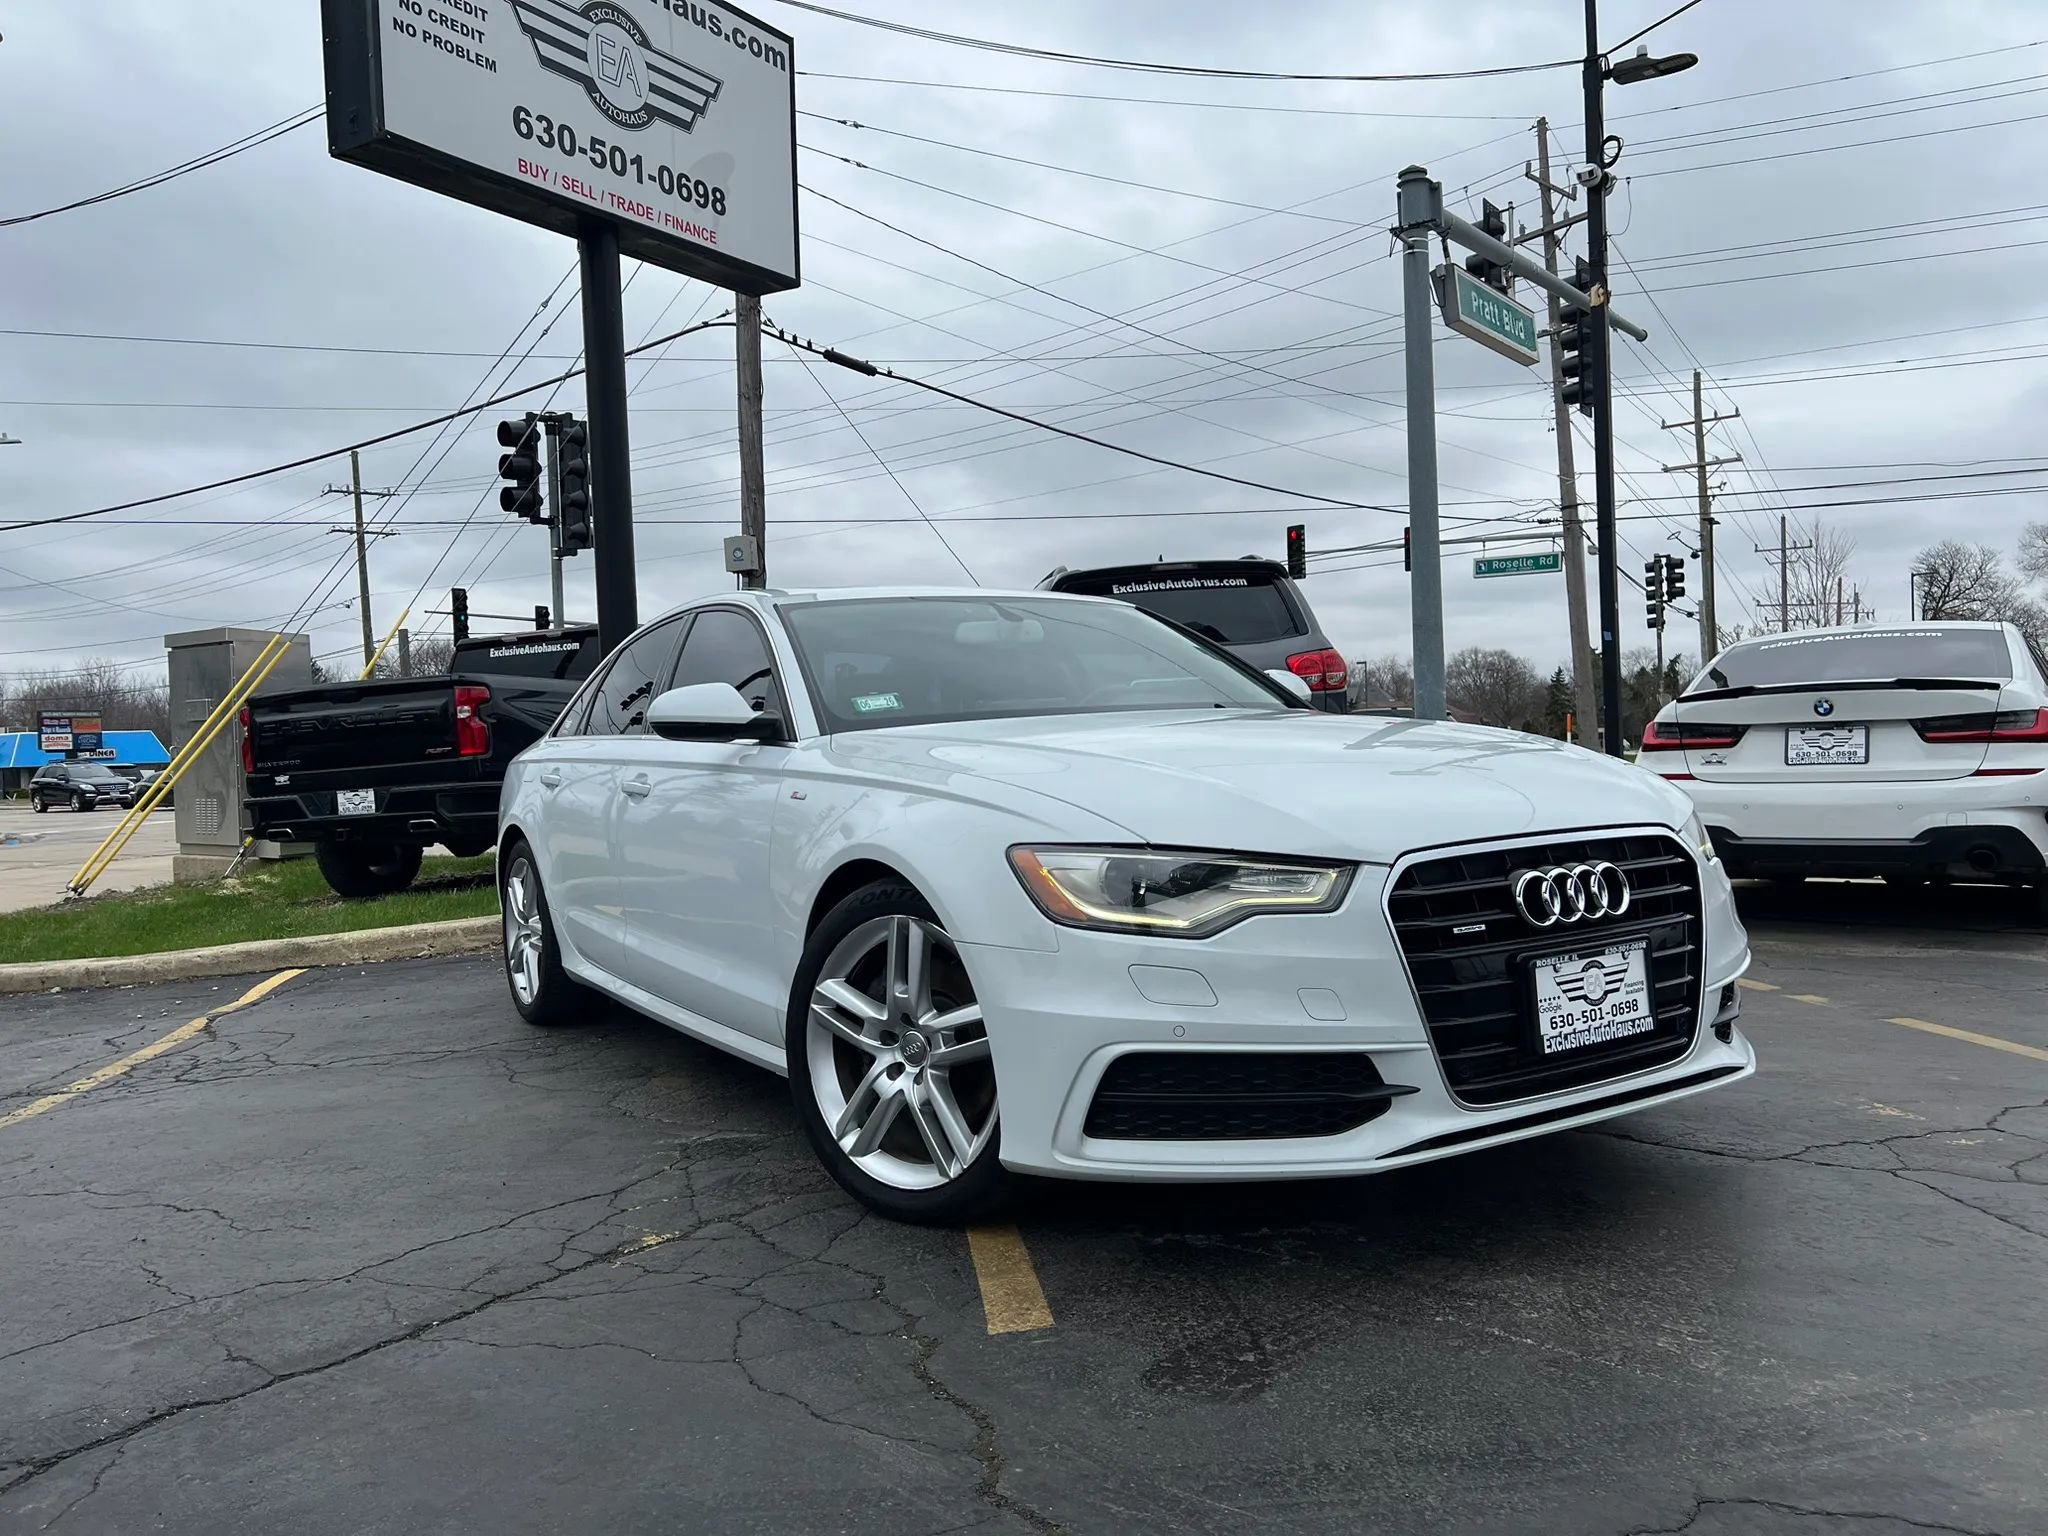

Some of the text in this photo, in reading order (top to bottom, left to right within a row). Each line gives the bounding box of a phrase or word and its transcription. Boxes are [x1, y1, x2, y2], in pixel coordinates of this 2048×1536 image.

[399, 0, 486, 44] NO CREDIT
[589, 8, 643, 44] EXCLUSIVE
[392, 16, 497, 73] NO PROBLEM
[596, 33, 642, 98] EA
[592, 92, 648, 124] AUTOHAUS
[512, 105, 727, 216] 630-501-0698
[518, 158, 717, 244] BUY / SELL / TRADE / FINANCE
[1471, 290, 1525, 340] Pratt Blvd
[1492, 557, 1534, 569] Roselle
[1539, 556, 1553, 565] Rd
[1112, 576, 1248, 594] ExclusiveAutohaus.com
[489, 642, 580, 657] ExclusiveAutohaus.com
[1536, 955, 1569, 967] ROSELLE
[1539, 1003, 1562, 1014] Google
[1549, 999, 1639, 1030] 630-501-0698
[1543, 1016, 1654, 1054] ExclusiveAutoHaus.com
